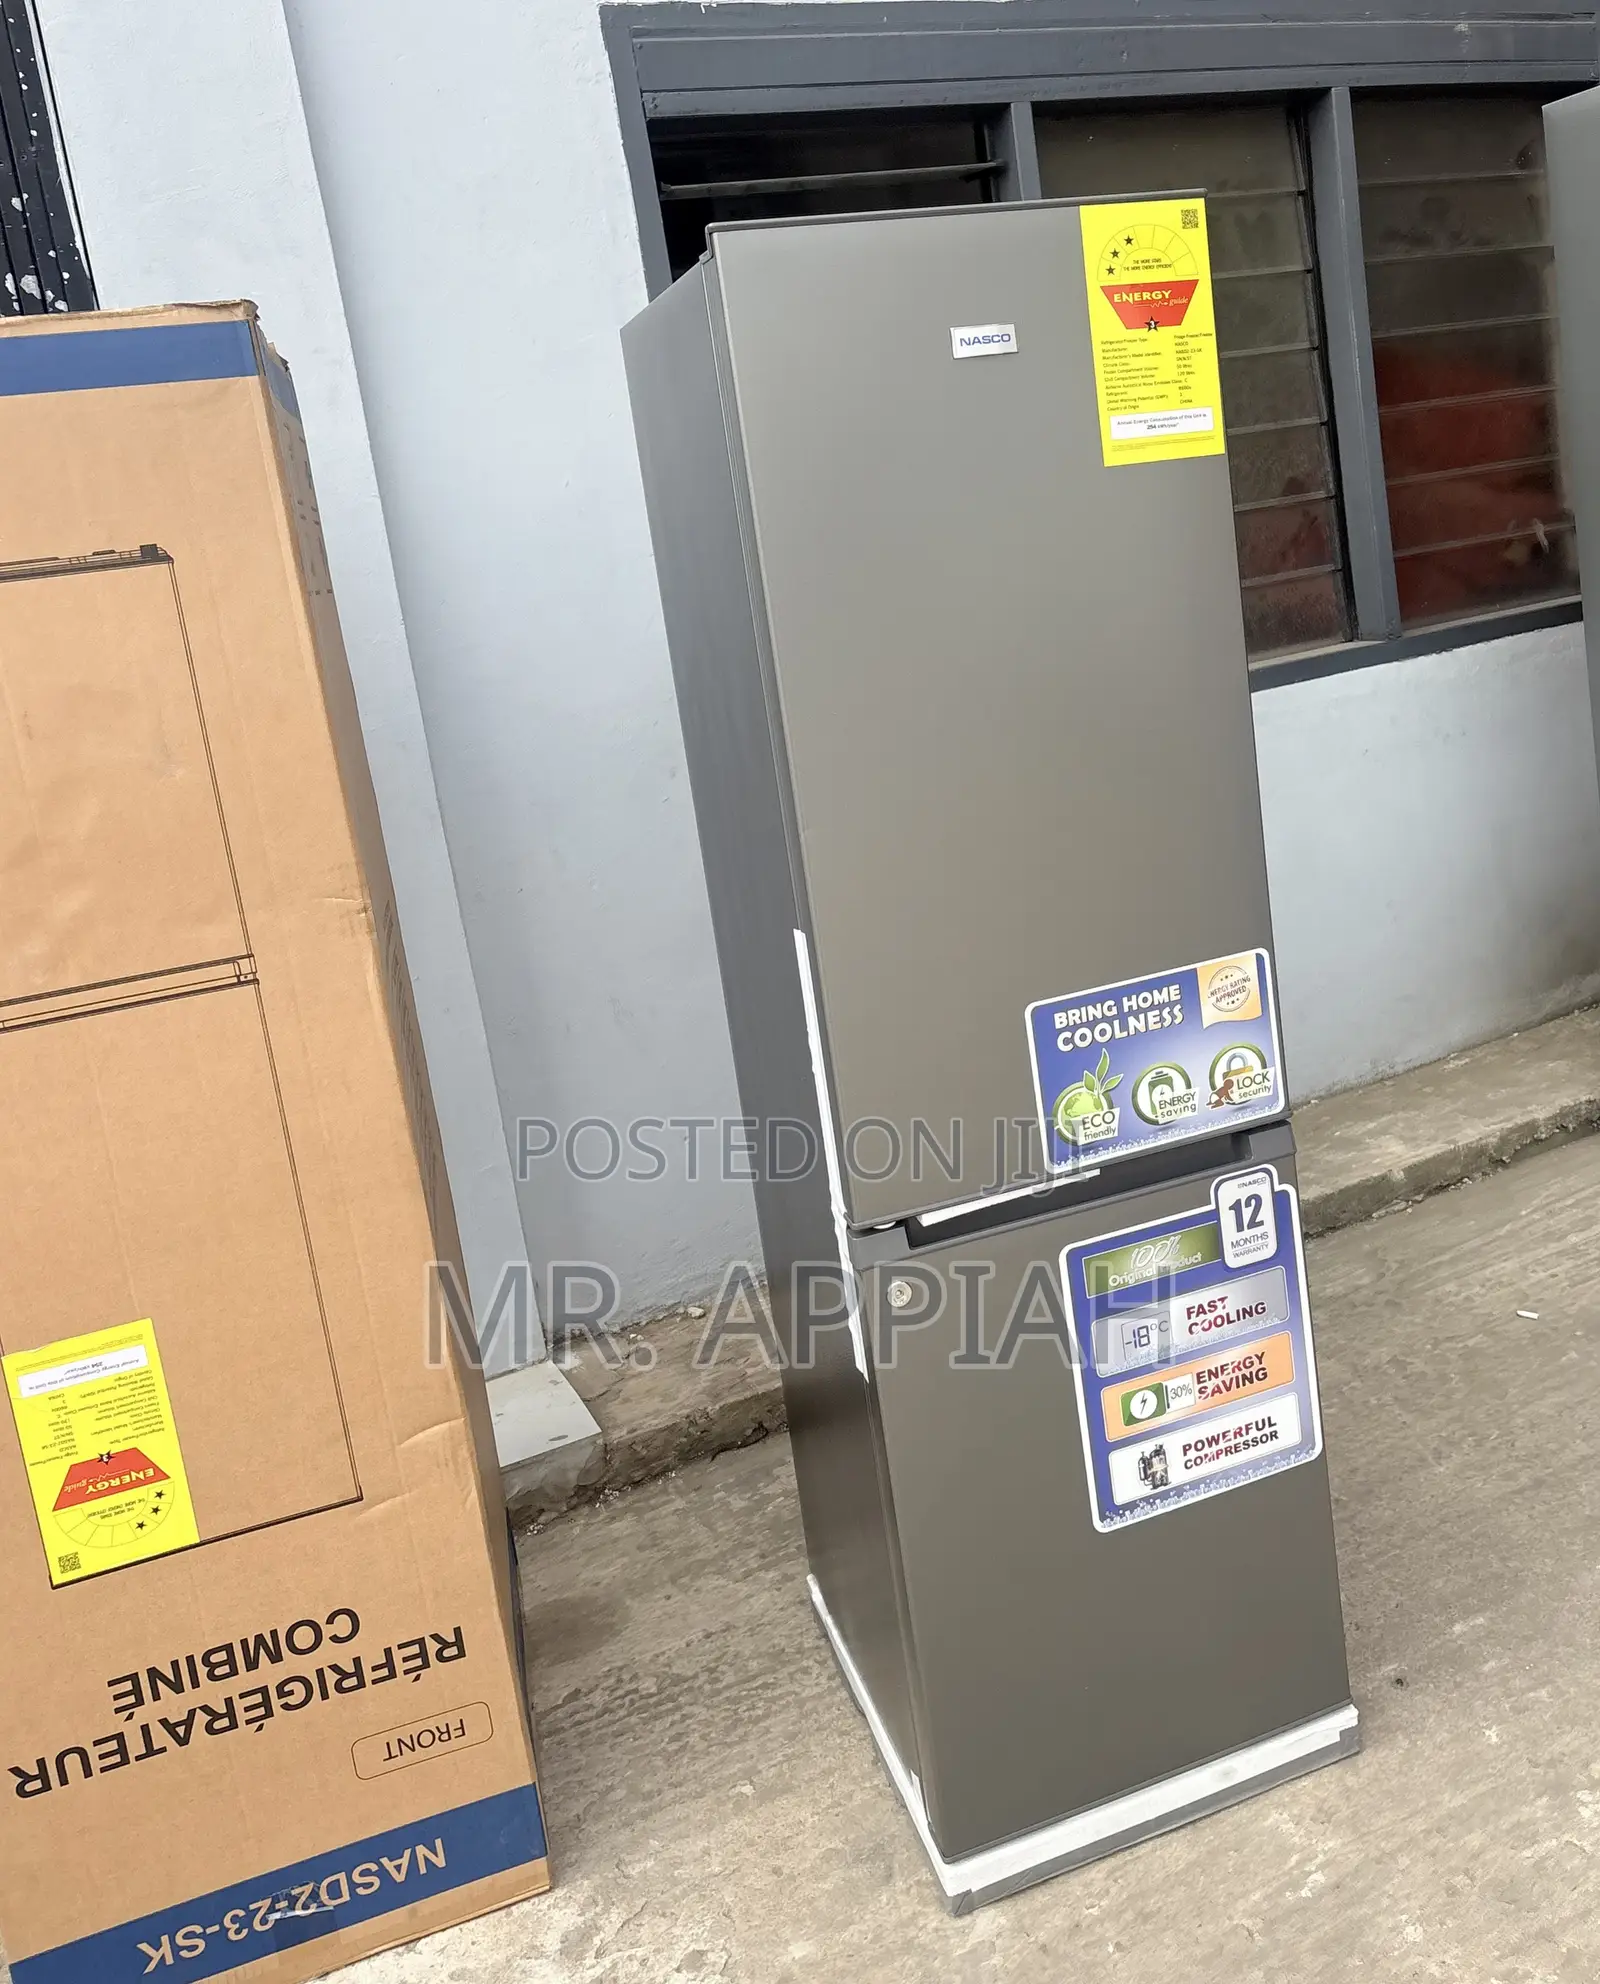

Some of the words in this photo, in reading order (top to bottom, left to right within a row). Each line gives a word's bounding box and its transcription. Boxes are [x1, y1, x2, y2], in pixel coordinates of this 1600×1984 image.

[1114, 290, 1172, 305] ENERGY
[1169, 296, 1188, 306] guide
[1150, 320, 1155, 328] 3
[960, 334, 1011, 346] NASCO
[1230, 975, 1250, 988] RATING
[1216, 986, 1246, 1003] APPROVED
[1054, 1000, 1118, 1030] BRING
[1123, 984, 1181, 1013] HOME
[1056, 1004, 1184, 1052] COOLNESS
[1237, 1071, 1270, 1090] LOCK
[1159, 1091, 1197, 1110] ENERGY
[1238, 1084, 1272, 1099] security
[1161, 1102, 1197, 1119] saving
[1082, 1111, 1115, 1130] ECO
[1084, 1127, 1116, 1141] friendly
[1242, 1177, 1267, 1188] NASCO
[1228, 1193, 1265, 1233] 12
[1230, 1232, 1269, 1250] MONTHS
[1130, 1234, 1181, 1269] 100%
[1233, 1244, 1269, 1259] WARRANTY
[1108, 1267, 1157, 1287] Original
[1186, 1296, 1228, 1320] FAST
[1188, 1301, 1267, 1336] COOLING
[1196, 1351, 1266, 1385] ENERGY
[1169, 1383, 1193, 1400] 30%
[1197, 1367, 1268, 1400] SAVING
[1182, 1416, 1277, 1456] POWERFUL
[1184, 1430, 1279, 1470] COMPRESSOR
[64, 1479, 87, 1493] guide
[85, 1468, 155, 1494] ENERGY
[106, 1607, 362, 1723] COMBINÉ
[7, 1625, 469, 1801] RÉFRIGÉRATEUR
[382, 1717, 467, 1762] FRONT
[136, 1836, 447, 1976] NASD2-23-SK
